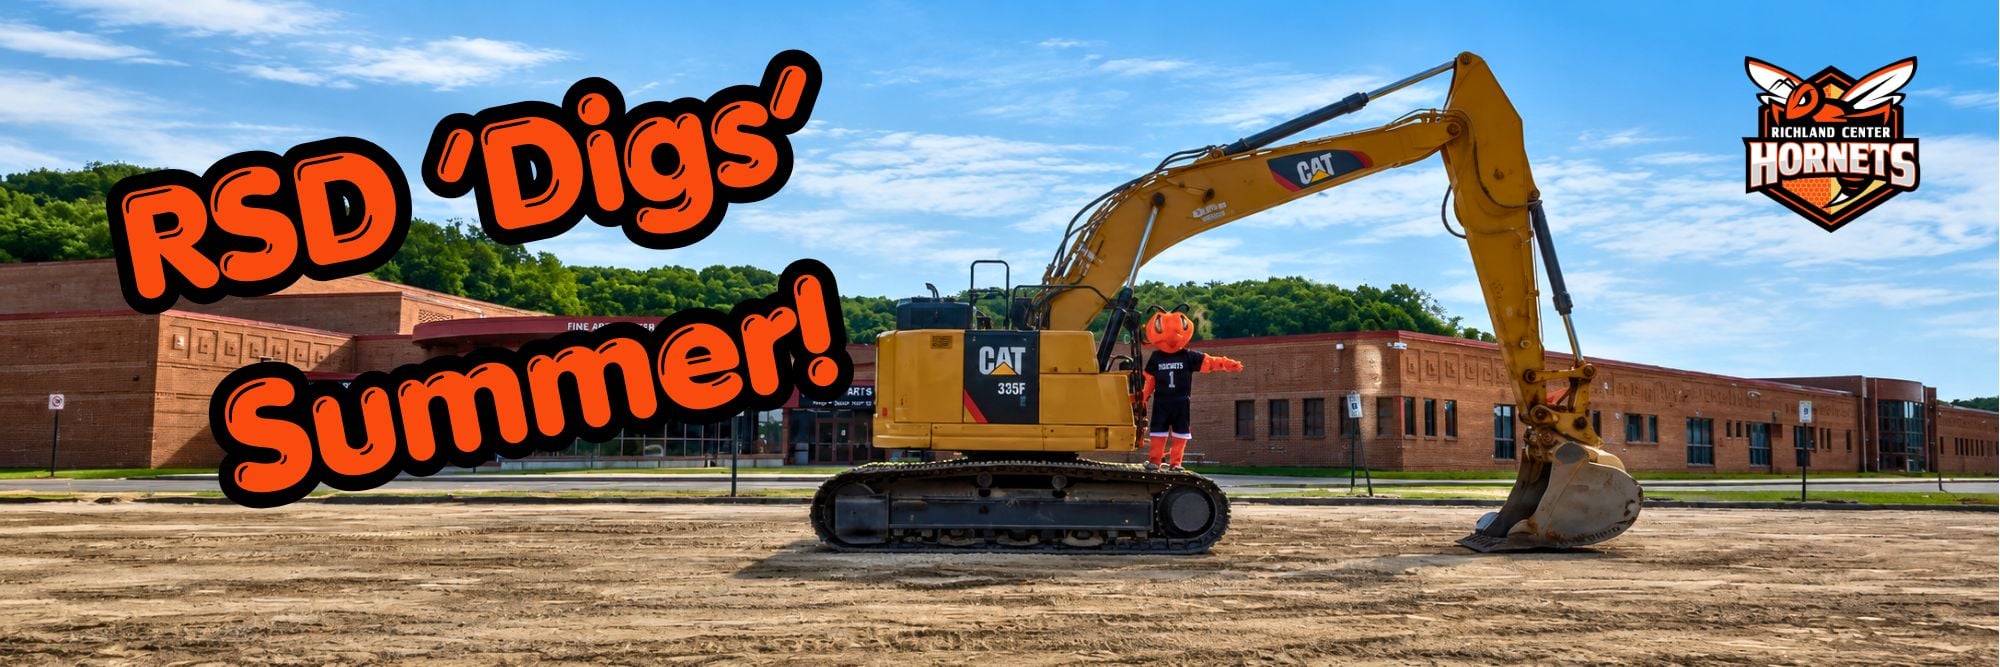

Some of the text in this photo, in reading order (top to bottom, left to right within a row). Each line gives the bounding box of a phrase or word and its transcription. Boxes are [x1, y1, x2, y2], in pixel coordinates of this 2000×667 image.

[1296, 152, 1335, 185] CAT
[567, 322, 589, 331] FINE
[978, 346, 1026, 375] CAT
[1168, 371, 1176, 388] 1
[847, 387, 873, 396] ARTS
[997, 382, 1026, 395] 335F
